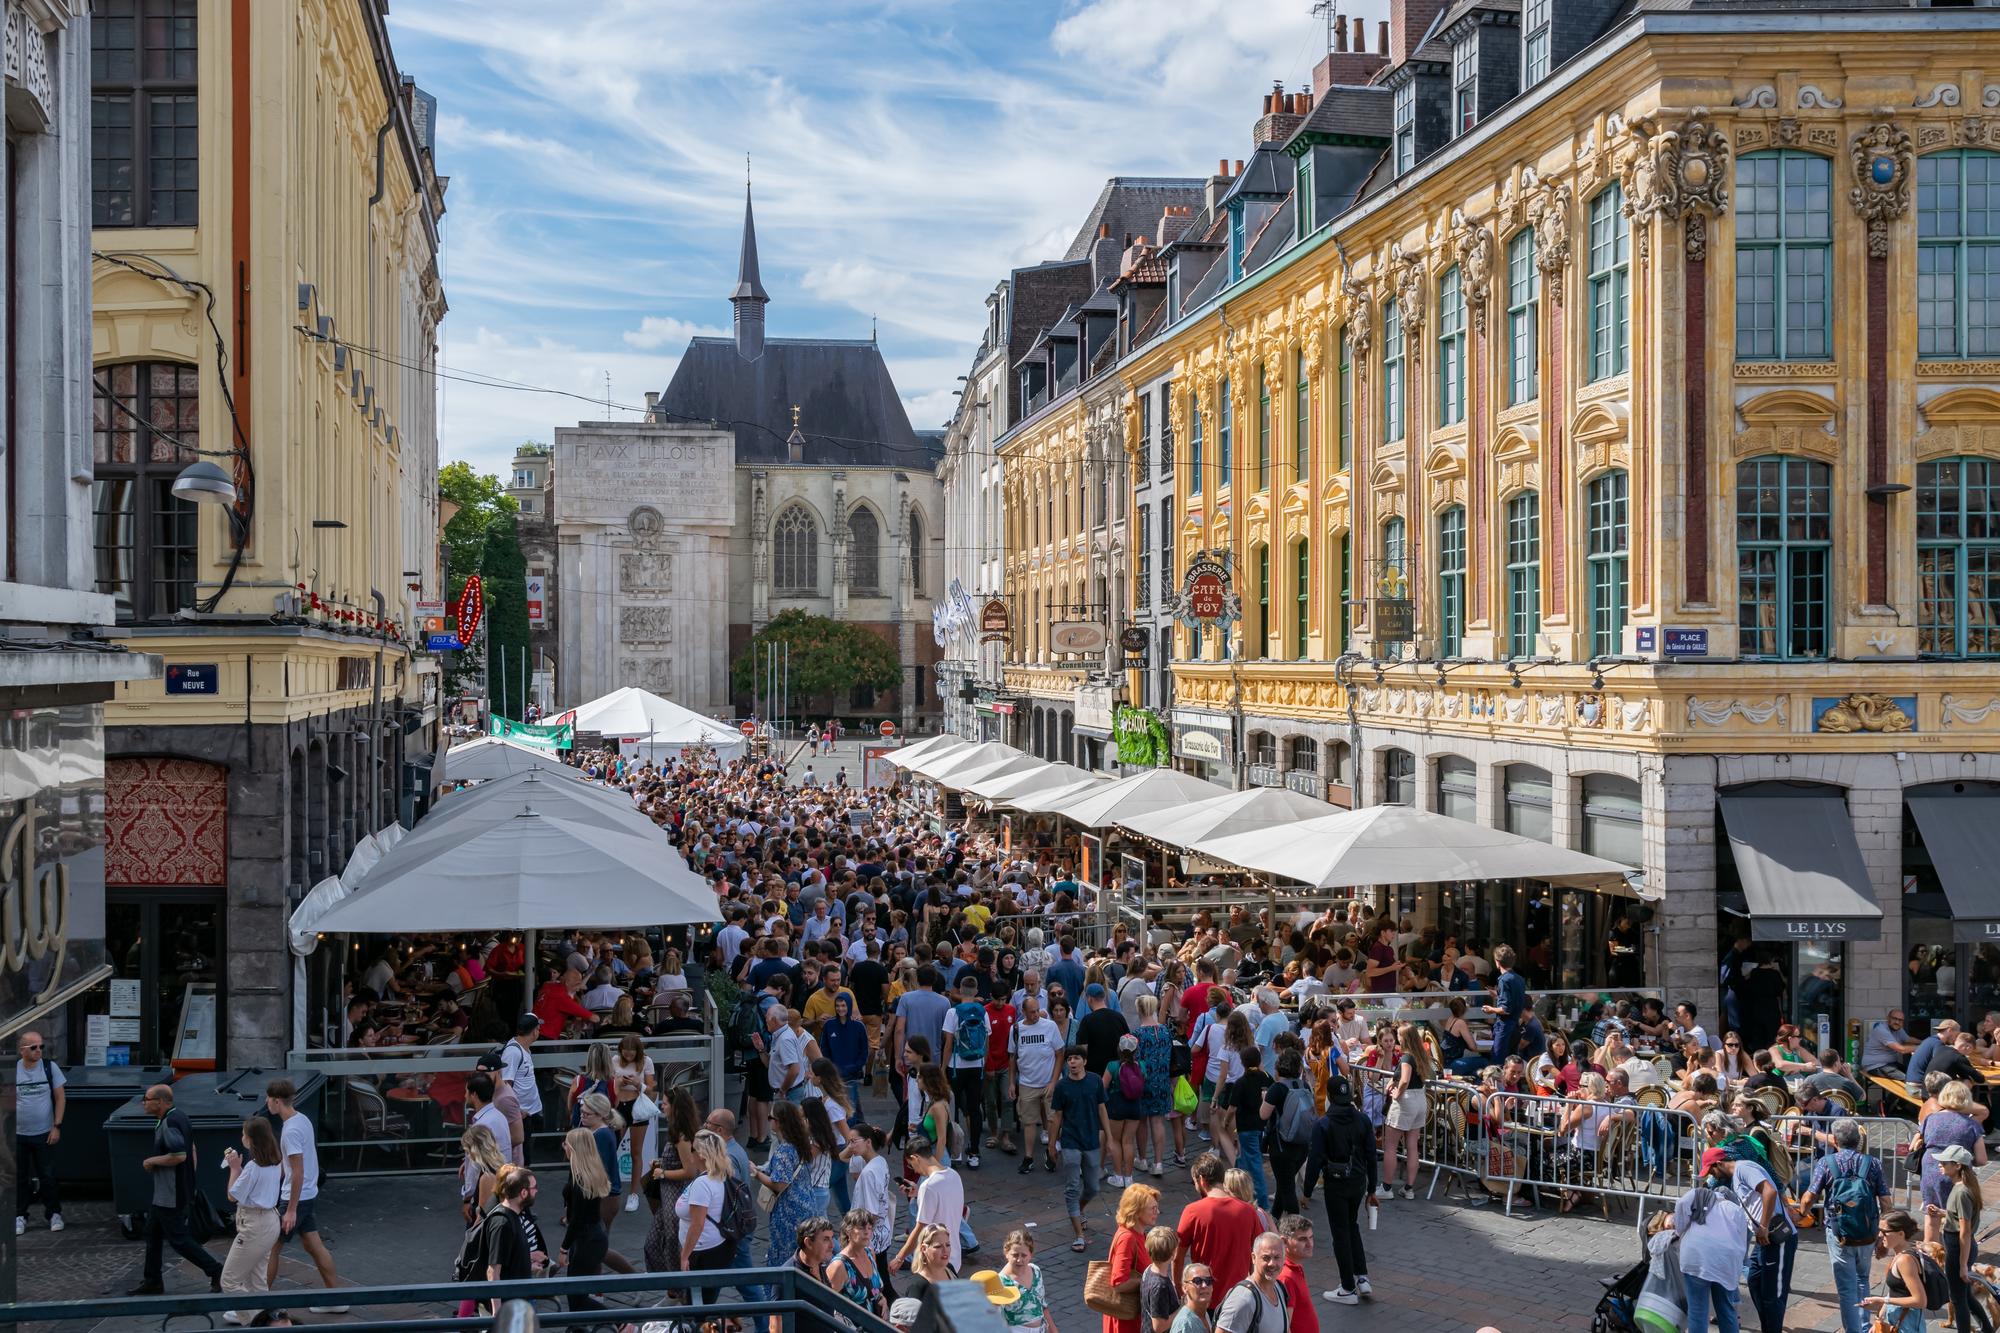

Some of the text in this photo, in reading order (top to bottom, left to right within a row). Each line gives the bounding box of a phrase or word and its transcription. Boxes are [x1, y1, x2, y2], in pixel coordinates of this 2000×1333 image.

[593, 446, 697, 461] AVX LILLOIS
[1188, 564, 1229, 582] BRASSERIE
[463, 589, 476, 631] TABAC
[1196, 602, 1220, 613] FOY
[1378, 606, 1412, 616] LE LYS
[1680, 633, 1701, 642] PLACE
[1056, 661, 1102, 670] Kronenbourg
[1124, 659, 1147, 668] BAR
[187, 669, 200, 678] Rue
[182, 681, 206, 690] NEUVE
[1299, 776, 1317, 795] FOY
[1786, 921, 1847, 934] LE LYS
[1020, 1034, 1046, 1045] PUMA
